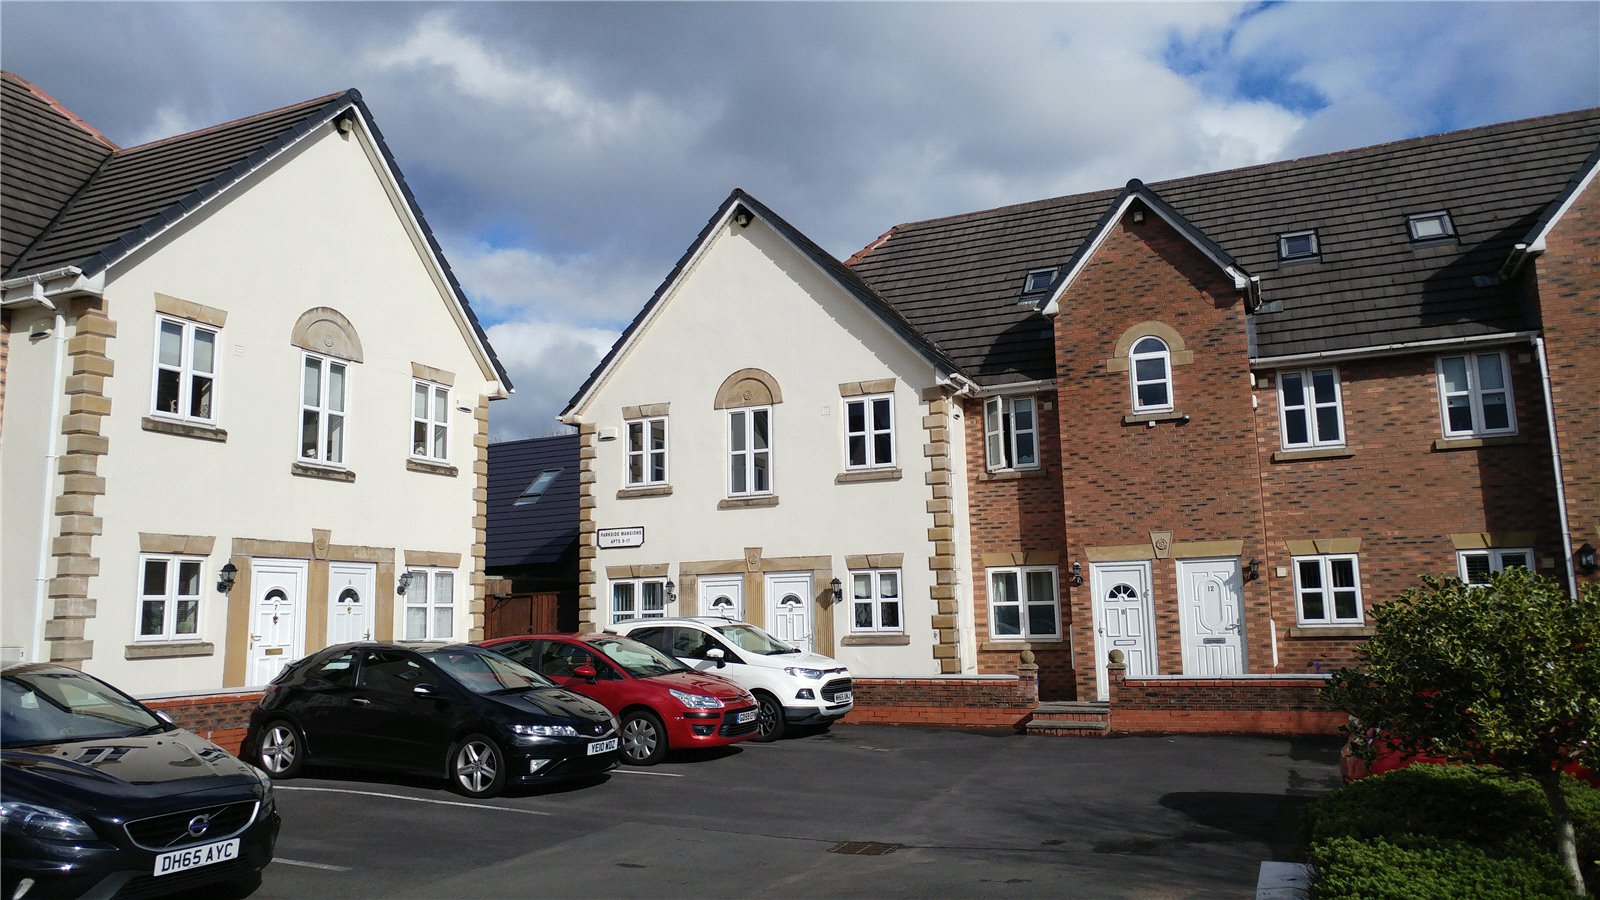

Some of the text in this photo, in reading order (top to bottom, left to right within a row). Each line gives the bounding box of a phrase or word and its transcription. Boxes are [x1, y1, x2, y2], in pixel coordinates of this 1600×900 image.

[591, 742, 605, 753] YE10
[161, 842, 233, 872] DH65 AYC
